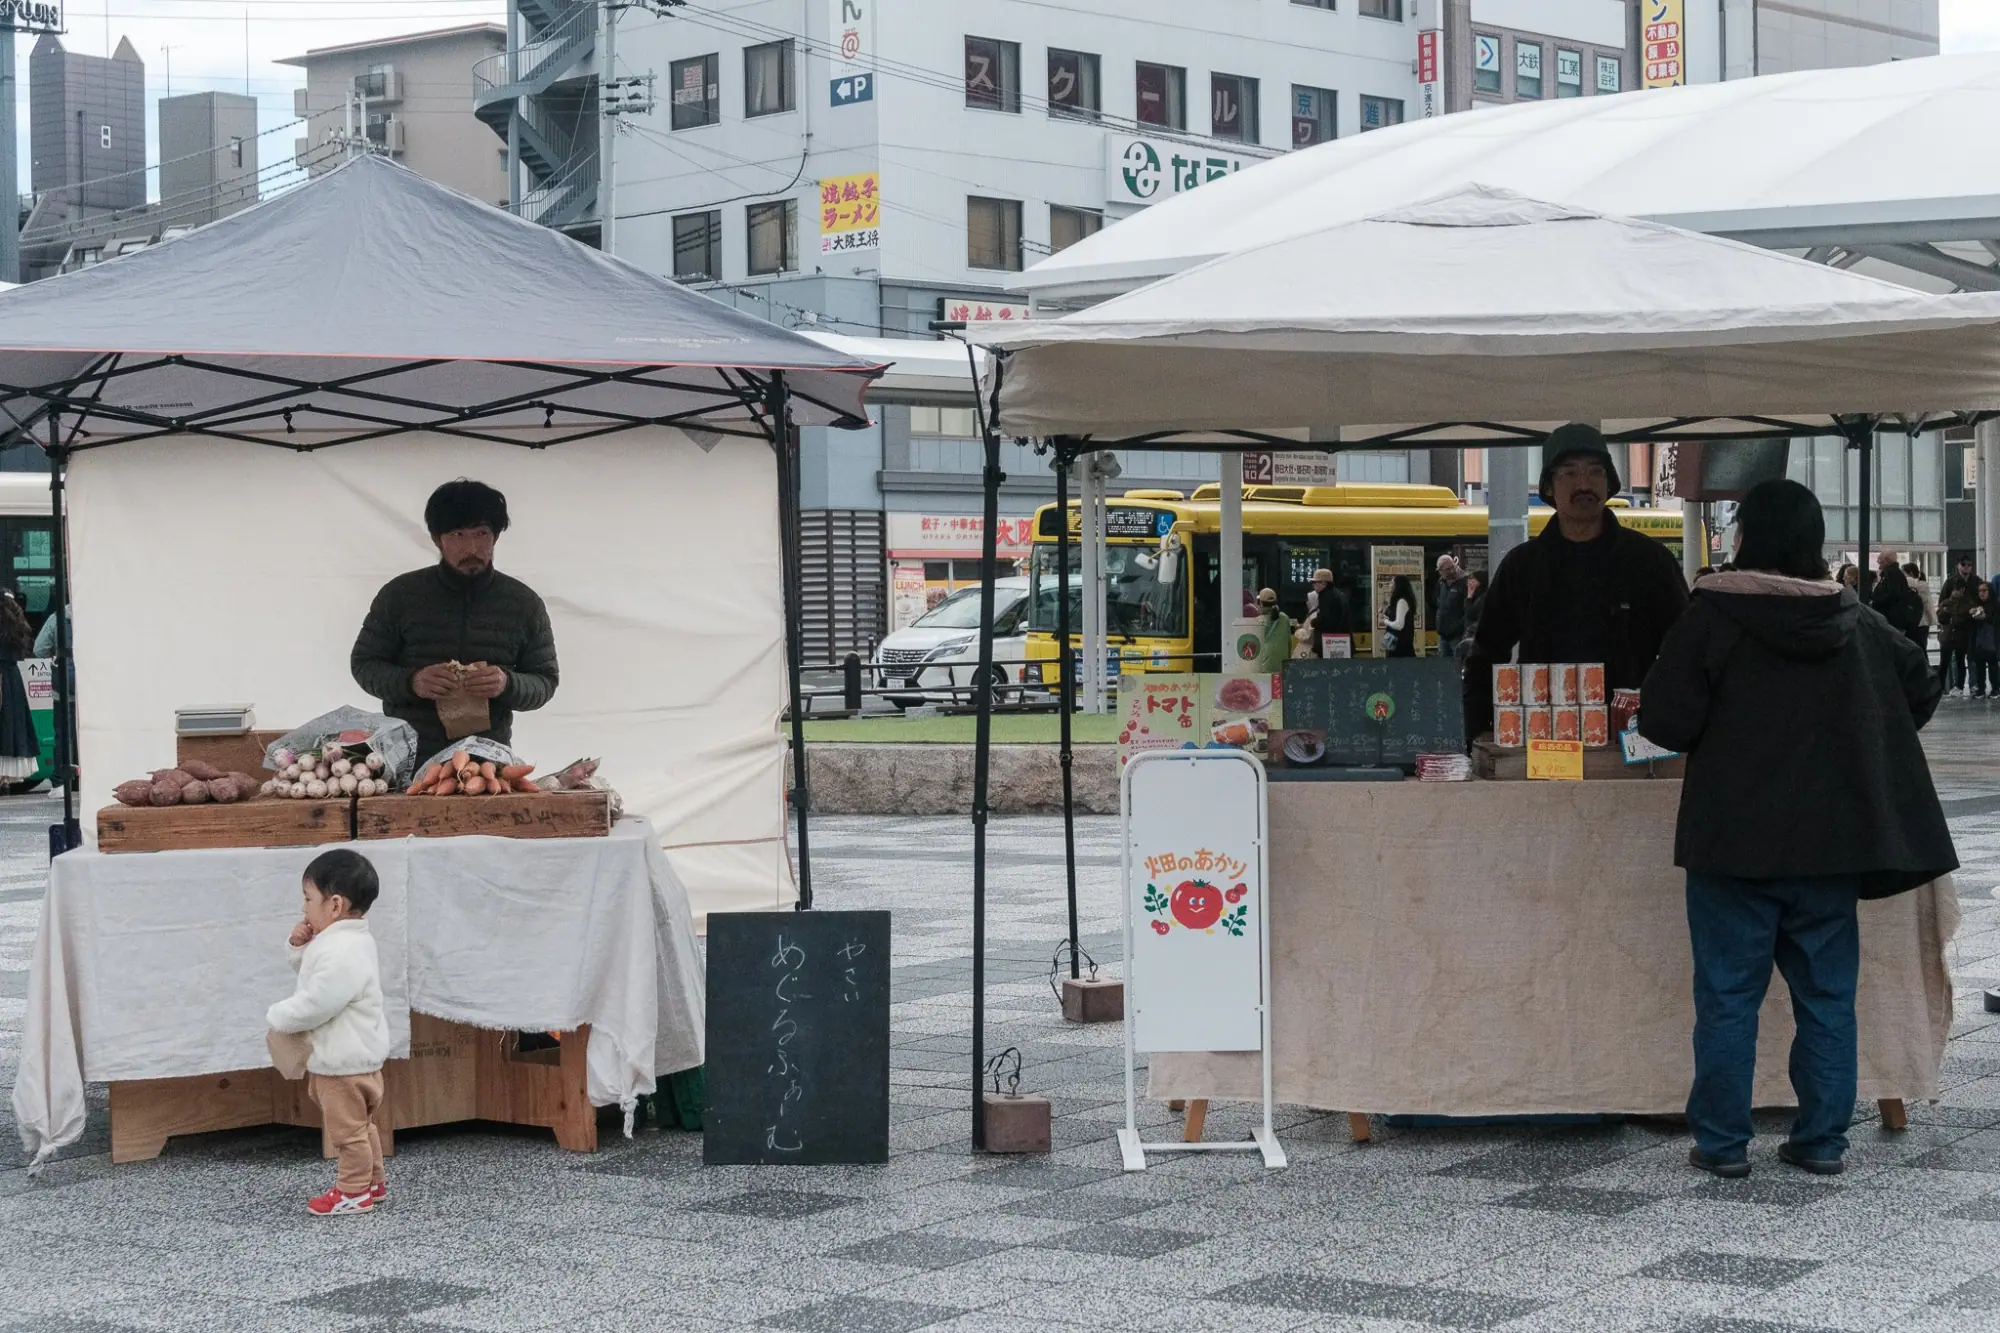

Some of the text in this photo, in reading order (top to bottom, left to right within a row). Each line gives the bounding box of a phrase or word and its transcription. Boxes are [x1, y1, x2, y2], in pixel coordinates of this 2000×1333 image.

[1647, 24, 1677, 40] 不動産
[1423, 33, 1432, 80] 個別指導
[1647, 62, 1678, 79] 事業者
[854, 76, 867, 99] P
[822, 178, 878, 204] 焼餃子
[823, 204, 878, 229] ラーメン
[832, 229, 879, 250] 大阪王将
[1259, 454, 1271, 480] 2
[895, 580, 925, 590] LUNCH
[1147, 695, 1195, 714] トマト
[1144, 848, 1248, 880] 畑のあかり
[837, 937, 866, 1003] やさい
